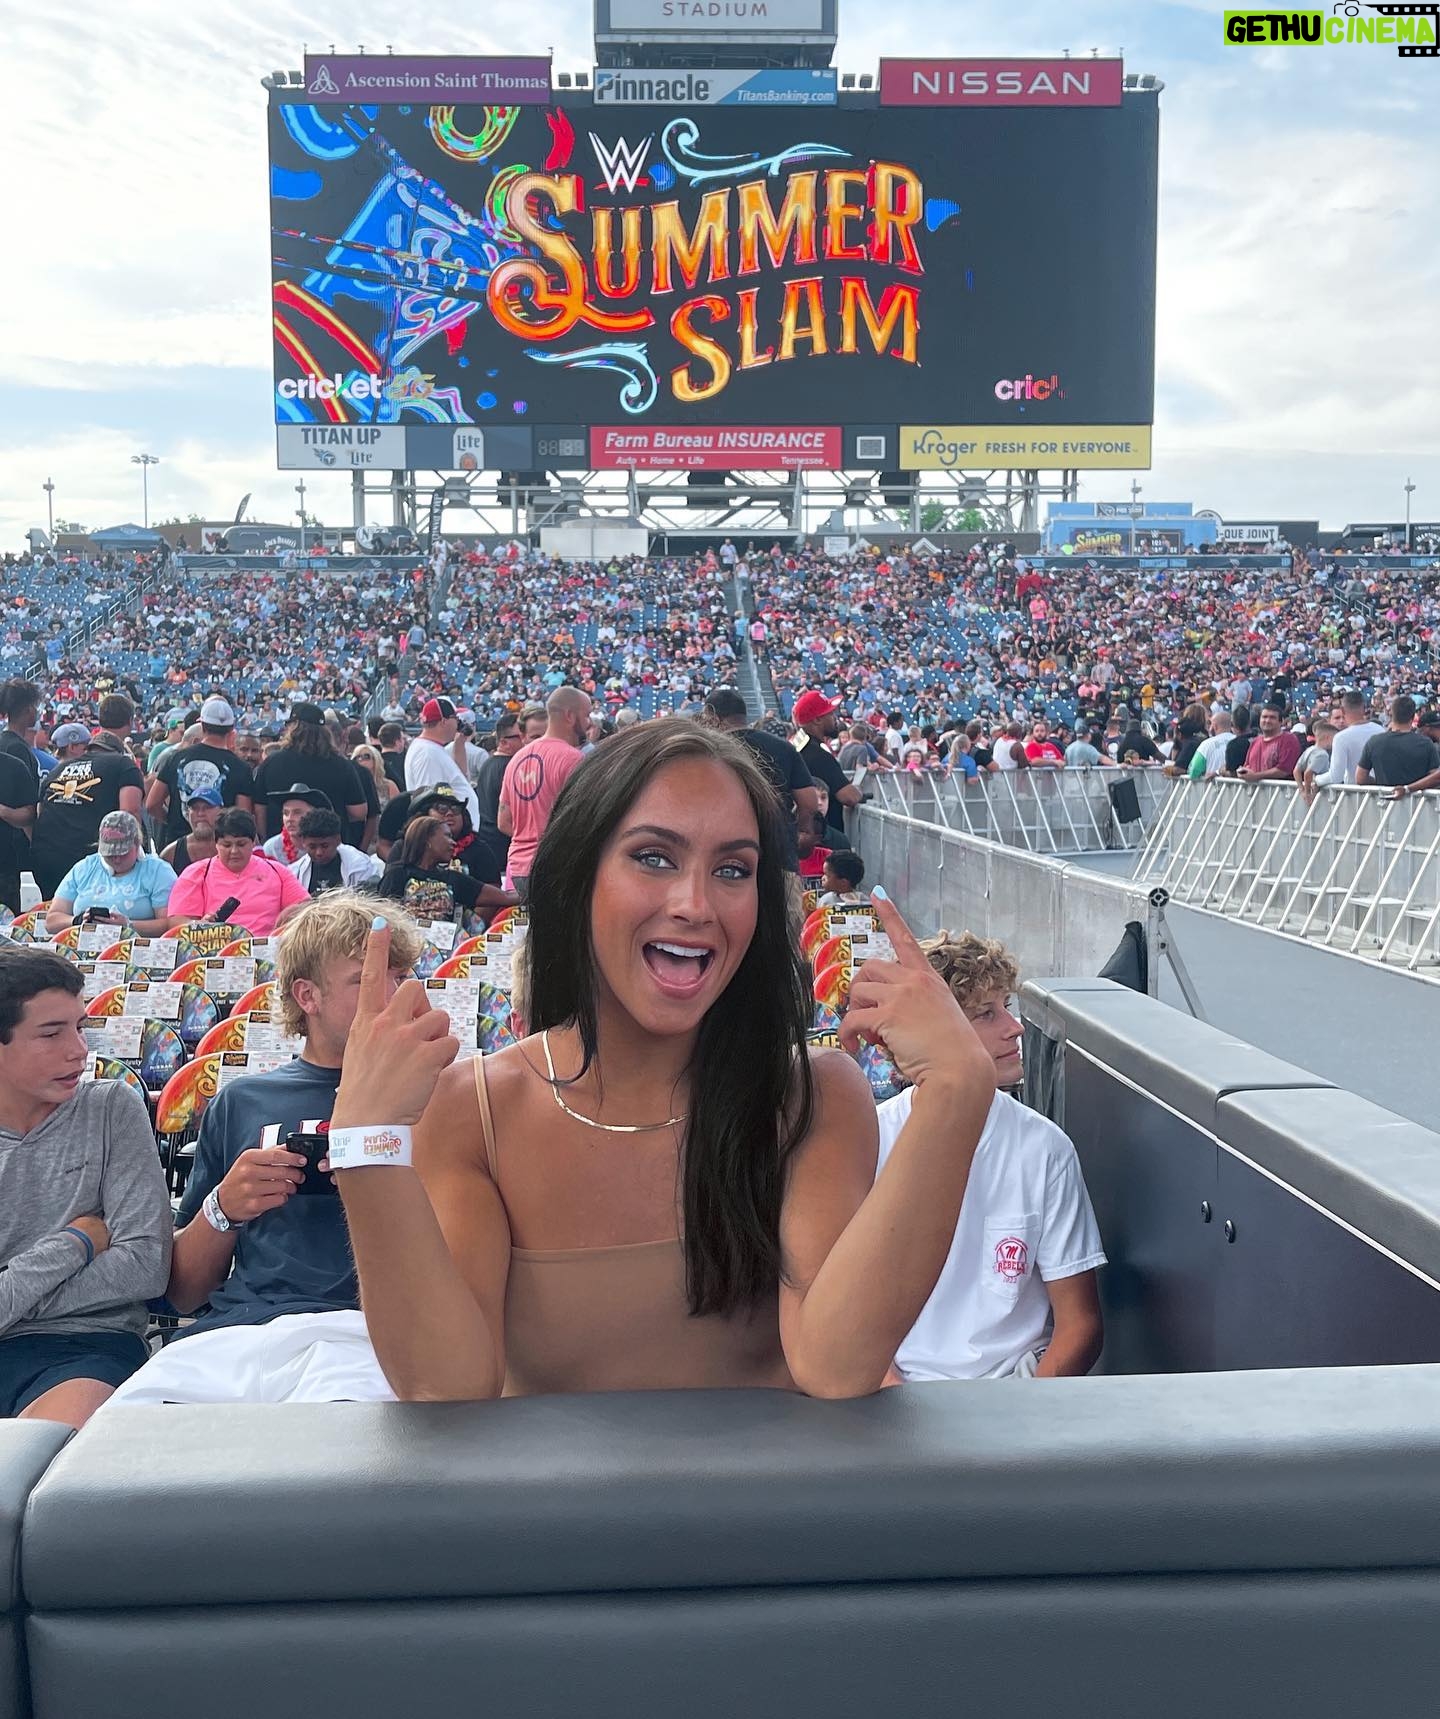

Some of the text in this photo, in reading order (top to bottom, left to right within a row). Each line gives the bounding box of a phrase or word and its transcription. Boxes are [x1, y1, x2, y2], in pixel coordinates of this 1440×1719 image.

[663, 2, 768, 17] STADIUM
[345, 72, 548, 89] Ascension Saint Thomas
[597, 73, 710, 101] Pinnacle
[912, 71, 1090, 95] NISSAN
[737, 89, 835, 104] TitansBanking.com
[487, 158, 926, 341] SUMMER
[670, 275, 922, 402] SLAM
[277, 373, 384, 400] cricket
[301, 428, 382, 444] TITAN UP
[456, 434, 481, 451] Lite
[605, 432, 825, 448] Farm Bureau INSURANCE
[913, 430, 1131, 466] Kroger FRESH FOR EVERYONE
[616, 456, 705, 465] Auto Home Life
[781, 456, 825, 465] Tennessee
[1247, 528, 1276, 539] JOINT
[180, 926, 232, 945] SUMMER
[997, 1260, 1025, 1274] REBELS
